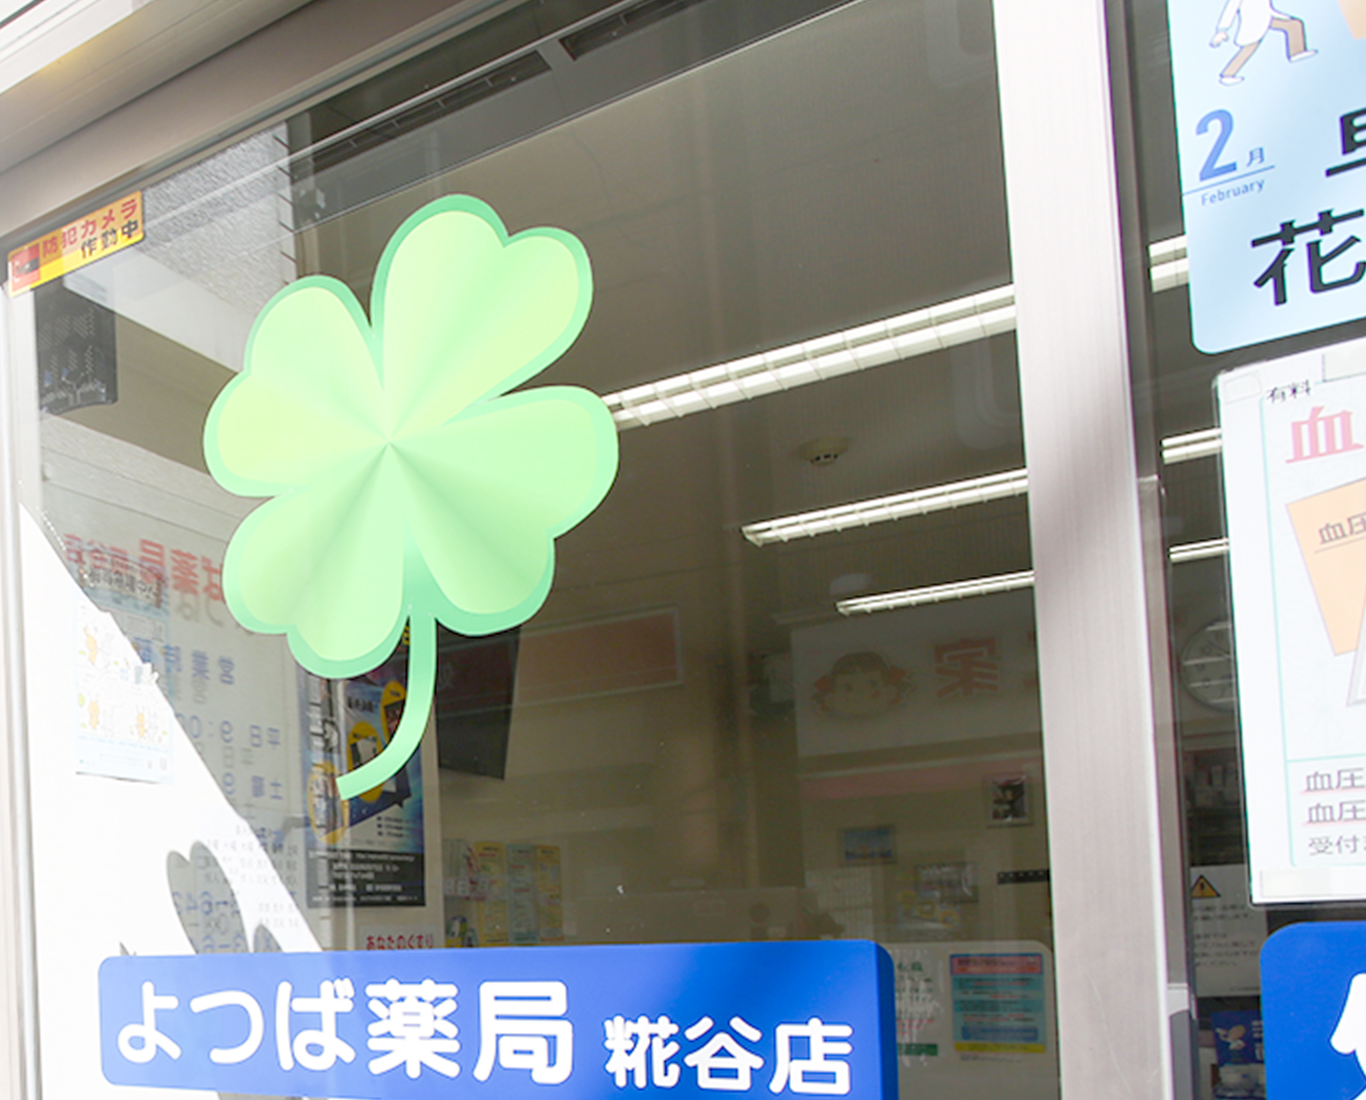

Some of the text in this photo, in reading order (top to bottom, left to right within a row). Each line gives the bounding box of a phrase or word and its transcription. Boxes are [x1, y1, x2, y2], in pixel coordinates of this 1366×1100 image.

[1195, 109, 1265, 182] 2月
[1200, 179, 1266, 206] February
[42, 198, 138, 258] 防犯カメラ
[80, 219, 139, 259] 作動中
[1250, 208, 1366, 307] 花
[1305, 767, 1366, 793] 血圧
[1307, 799, 1366, 825] 血圧
[1309, 834, 1366, 857] 受付
[116, 976, 854, 1097] よつば薬局 糀谷店
